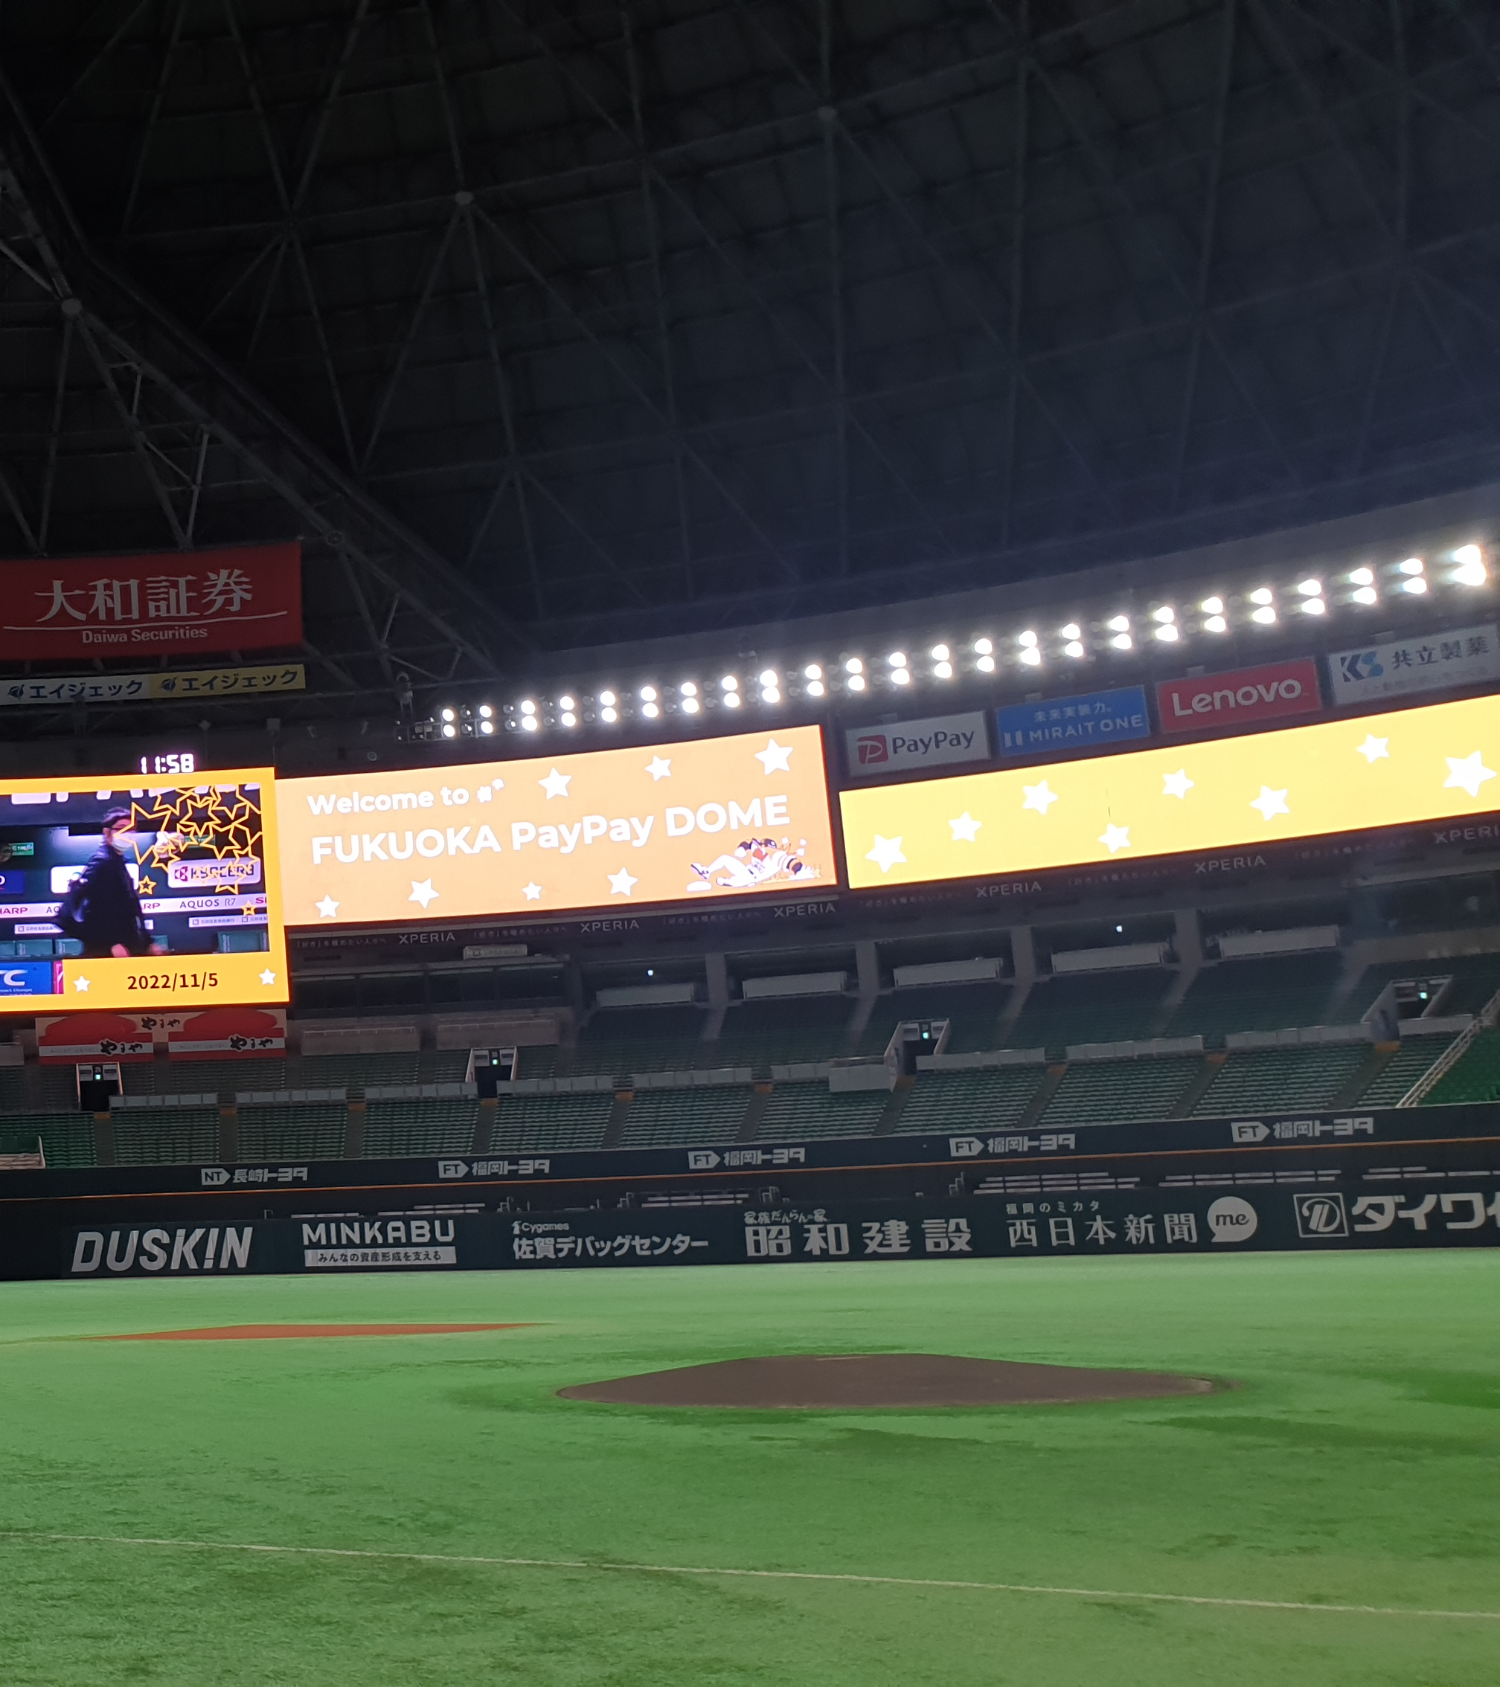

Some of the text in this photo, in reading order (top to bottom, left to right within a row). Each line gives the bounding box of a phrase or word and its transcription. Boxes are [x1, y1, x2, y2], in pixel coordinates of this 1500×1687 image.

[34, 568, 253, 623] 大和証券
[82, 625, 208, 645] Daiwa Securities
[29, 679, 144, 699] エイジェック
[181, 668, 299, 691] エイジェック
[1171, 676, 1302, 717] Lenovo
[1029, 714, 1144, 743] MIRAIT ONE
[892, 728, 976, 759] PayPay
[140, 753, 195, 774] 11:58
[307, 784, 469, 816] Welcome to
[311, 795, 791, 865] FUKUOKA PayPay DOME
[1195, 855, 1267, 874] XPERIA
[975, 880, 1042, 898] XPERIA
[179, 899, 220, 910] AQUOS
[773, 902, 836, 918] XPERIA
[580, 919, 640, 933] XPERIA
[399, 931, 456, 945] XPERIA
[127, 972, 219, 992] 2022/11/5
[1238, 1117, 1374, 1139] FT 福岡トヨタ
[956, 1133, 1076, 1153] FT 福岡トヨタ
[694, 1147, 806, 1167] FT 福岡トヨタ
[204, 1166, 308, 1183] NT 長崎トヨタ
[444, 1158, 550, 1177] FT 福岡トヨタ
[1006, 1200, 1100, 1215] 福岡のミカタ
[521, 1221, 570, 1233] Cygames
[1215, 1211, 1250, 1228] me
[302, 1219, 455, 1246] MINKABU
[744, 1218, 973, 1257] 昭和建設
[1006, 1213, 1198, 1248] 西日本新聞
[318, 1250, 442, 1263] みんなの資産形成を支える
[513, 1233, 709, 1260] 佐賀デバッグセンター
